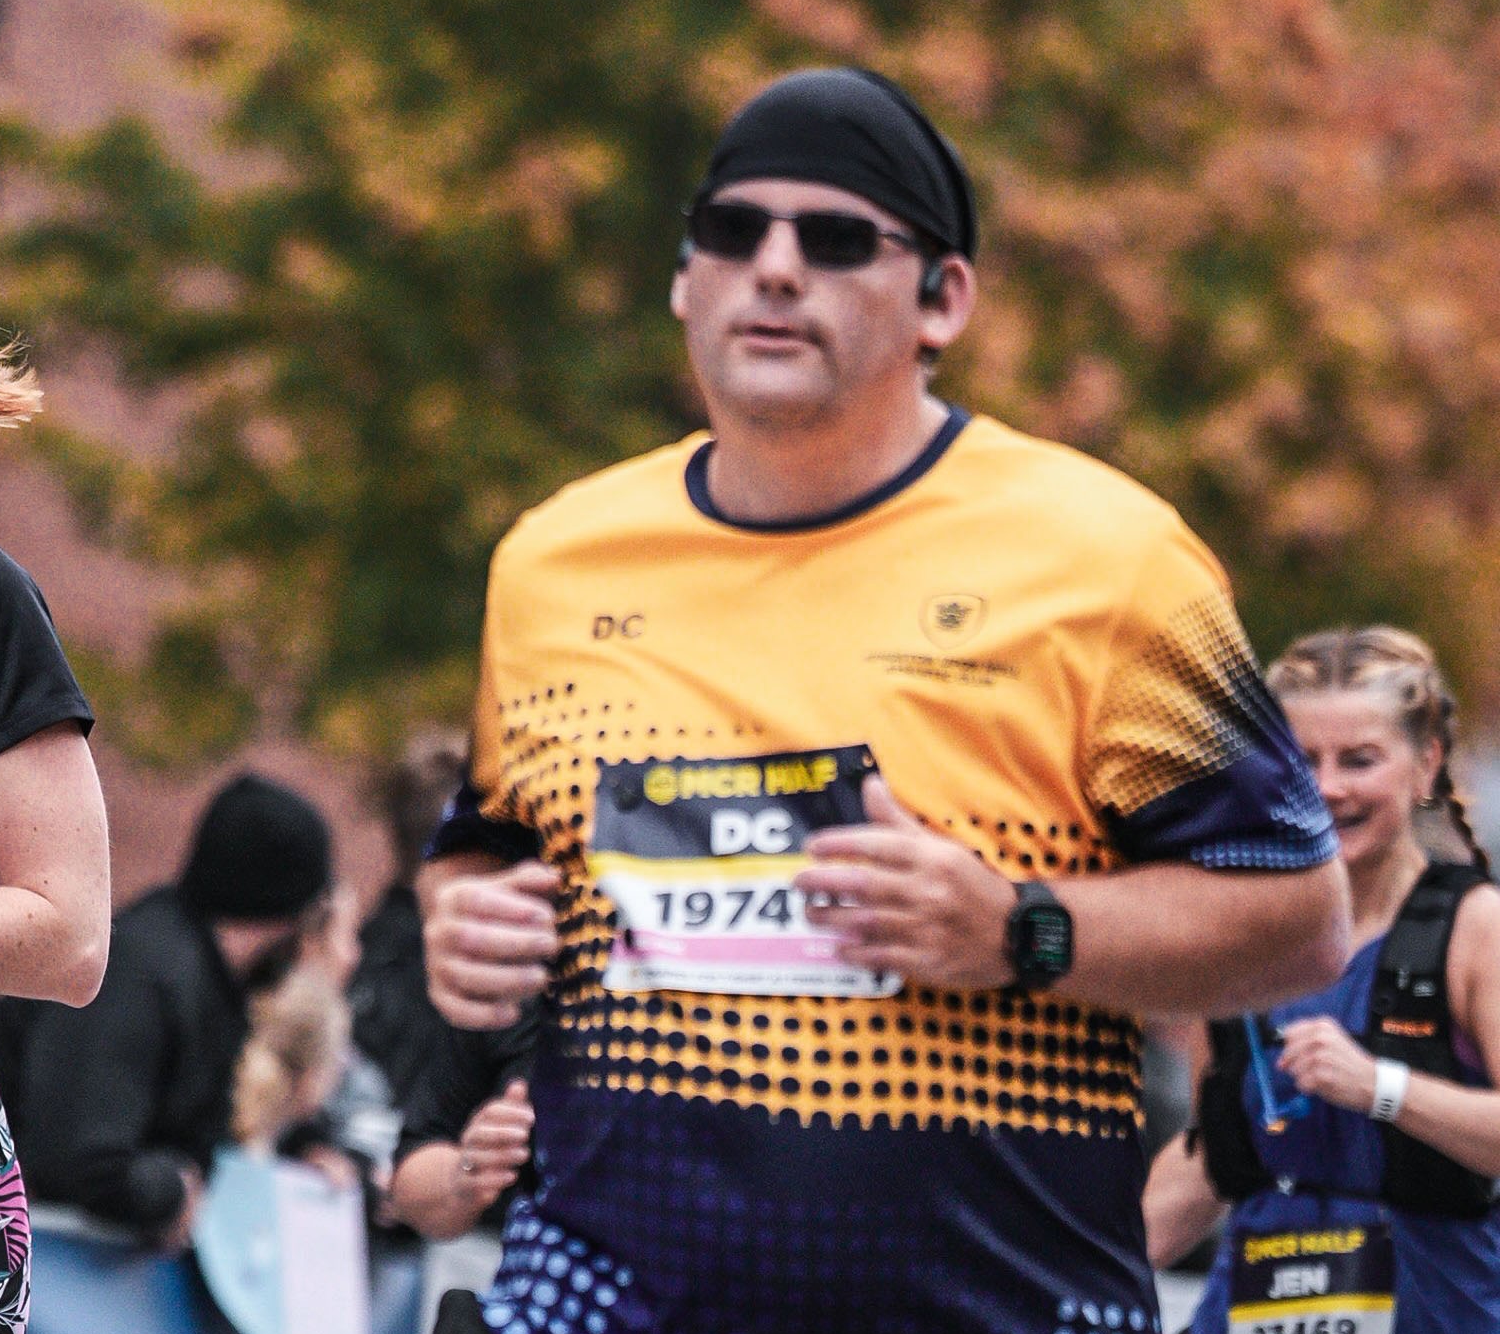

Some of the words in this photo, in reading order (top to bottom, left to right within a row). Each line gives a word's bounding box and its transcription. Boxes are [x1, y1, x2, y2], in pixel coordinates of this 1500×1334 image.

[592, 613, 646, 642] DC
[709, 805, 794, 856] DC
[1268, 1261, 1331, 1300] JEN
